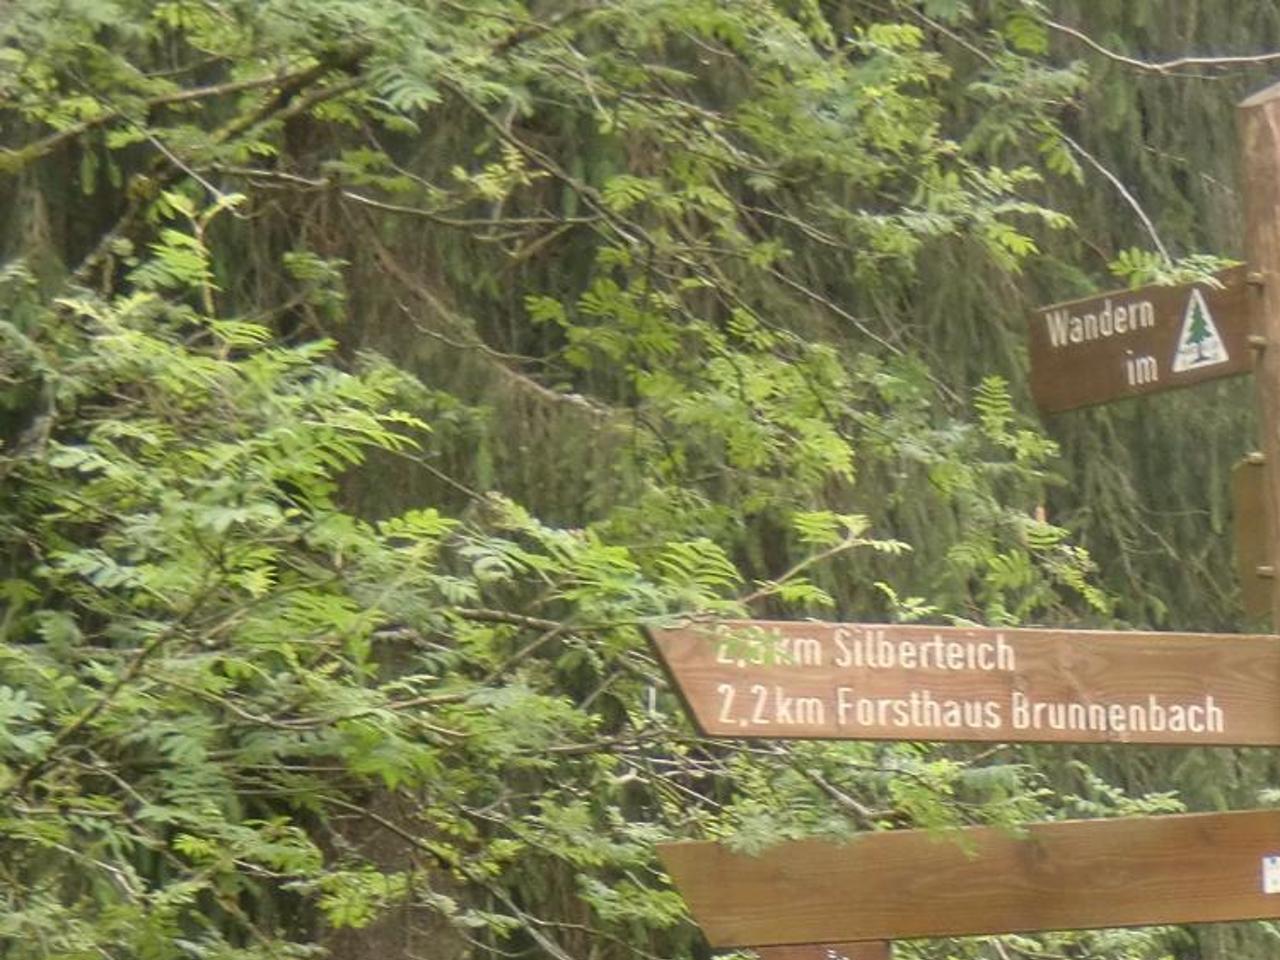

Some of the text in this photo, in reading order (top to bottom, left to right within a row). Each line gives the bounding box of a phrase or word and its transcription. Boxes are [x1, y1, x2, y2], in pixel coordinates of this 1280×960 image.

[1045, 299, 1156, 348] Wandern
[1125, 349, 1159, 386] im
[834, 627, 1016, 671] Silberteich
[837, 686, 1001, 729] Forsthaus
[1011, 692, 1225, 733] Brunnenbach
